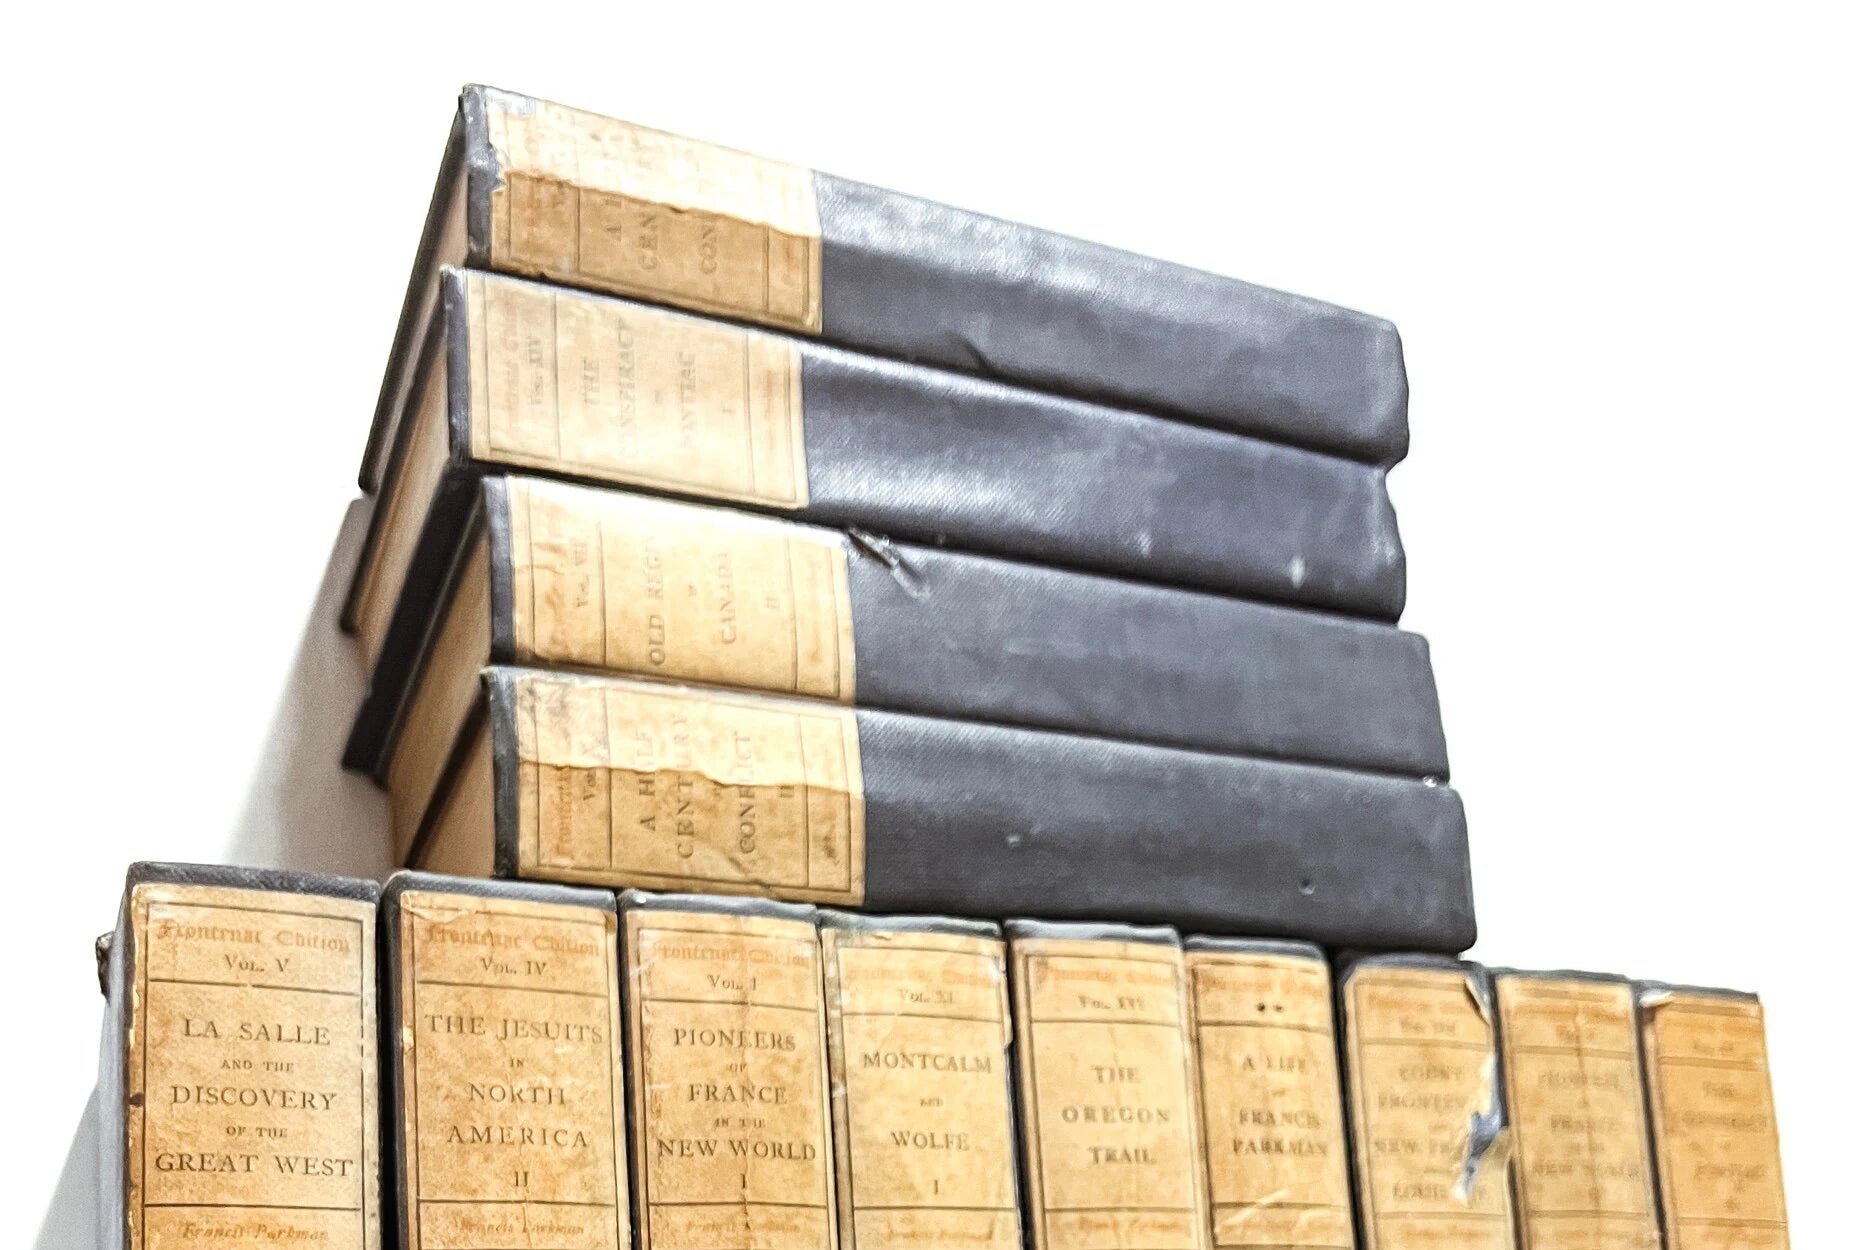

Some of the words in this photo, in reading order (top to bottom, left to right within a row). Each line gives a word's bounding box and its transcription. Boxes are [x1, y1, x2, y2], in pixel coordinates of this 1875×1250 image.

[647, 614, 666, 667] OLD
[638, 815, 656, 833] A
[274, 957, 290, 973] V
[525, 959, 548, 977] IV
[183, 1017, 222, 1039] LA
[238, 1020, 332, 1046] SALLE
[424, 1013, 486, 1036] THE
[497, 1018, 602, 1044] JESUITS
[673, 1027, 797, 1052] PIONEERS
[221, 1058, 253, 1071] AND
[260, 1060, 295, 1073] THE
[509, 1057, 525, 1069] IN
[862, 1050, 993, 1075] MONTCALM
[1091, 1065, 1141, 1085] THE
[169, 1085, 338, 1111] DISCOVERY
[468, 1081, 567, 1107] NORTH
[689, 1083, 788, 1106] FRANCE
[1061, 1105, 1171, 1125] OREGON
[225, 1125, 247, 1138] OF
[256, 1126, 289, 1139] THE
[446, 1125, 589, 1149] AMERICA
[890, 1129, 971, 1151] WOLFE
[657, 1138, 718, 1159] NEW
[727, 1138, 817, 1162] WORLD
[1088, 1146, 1157, 1165] TRAIL
[154, 1151, 260, 1174] GREAT
[274, 1154, 355, 1177] WEST
[512, 1169, 530, 1189] II
